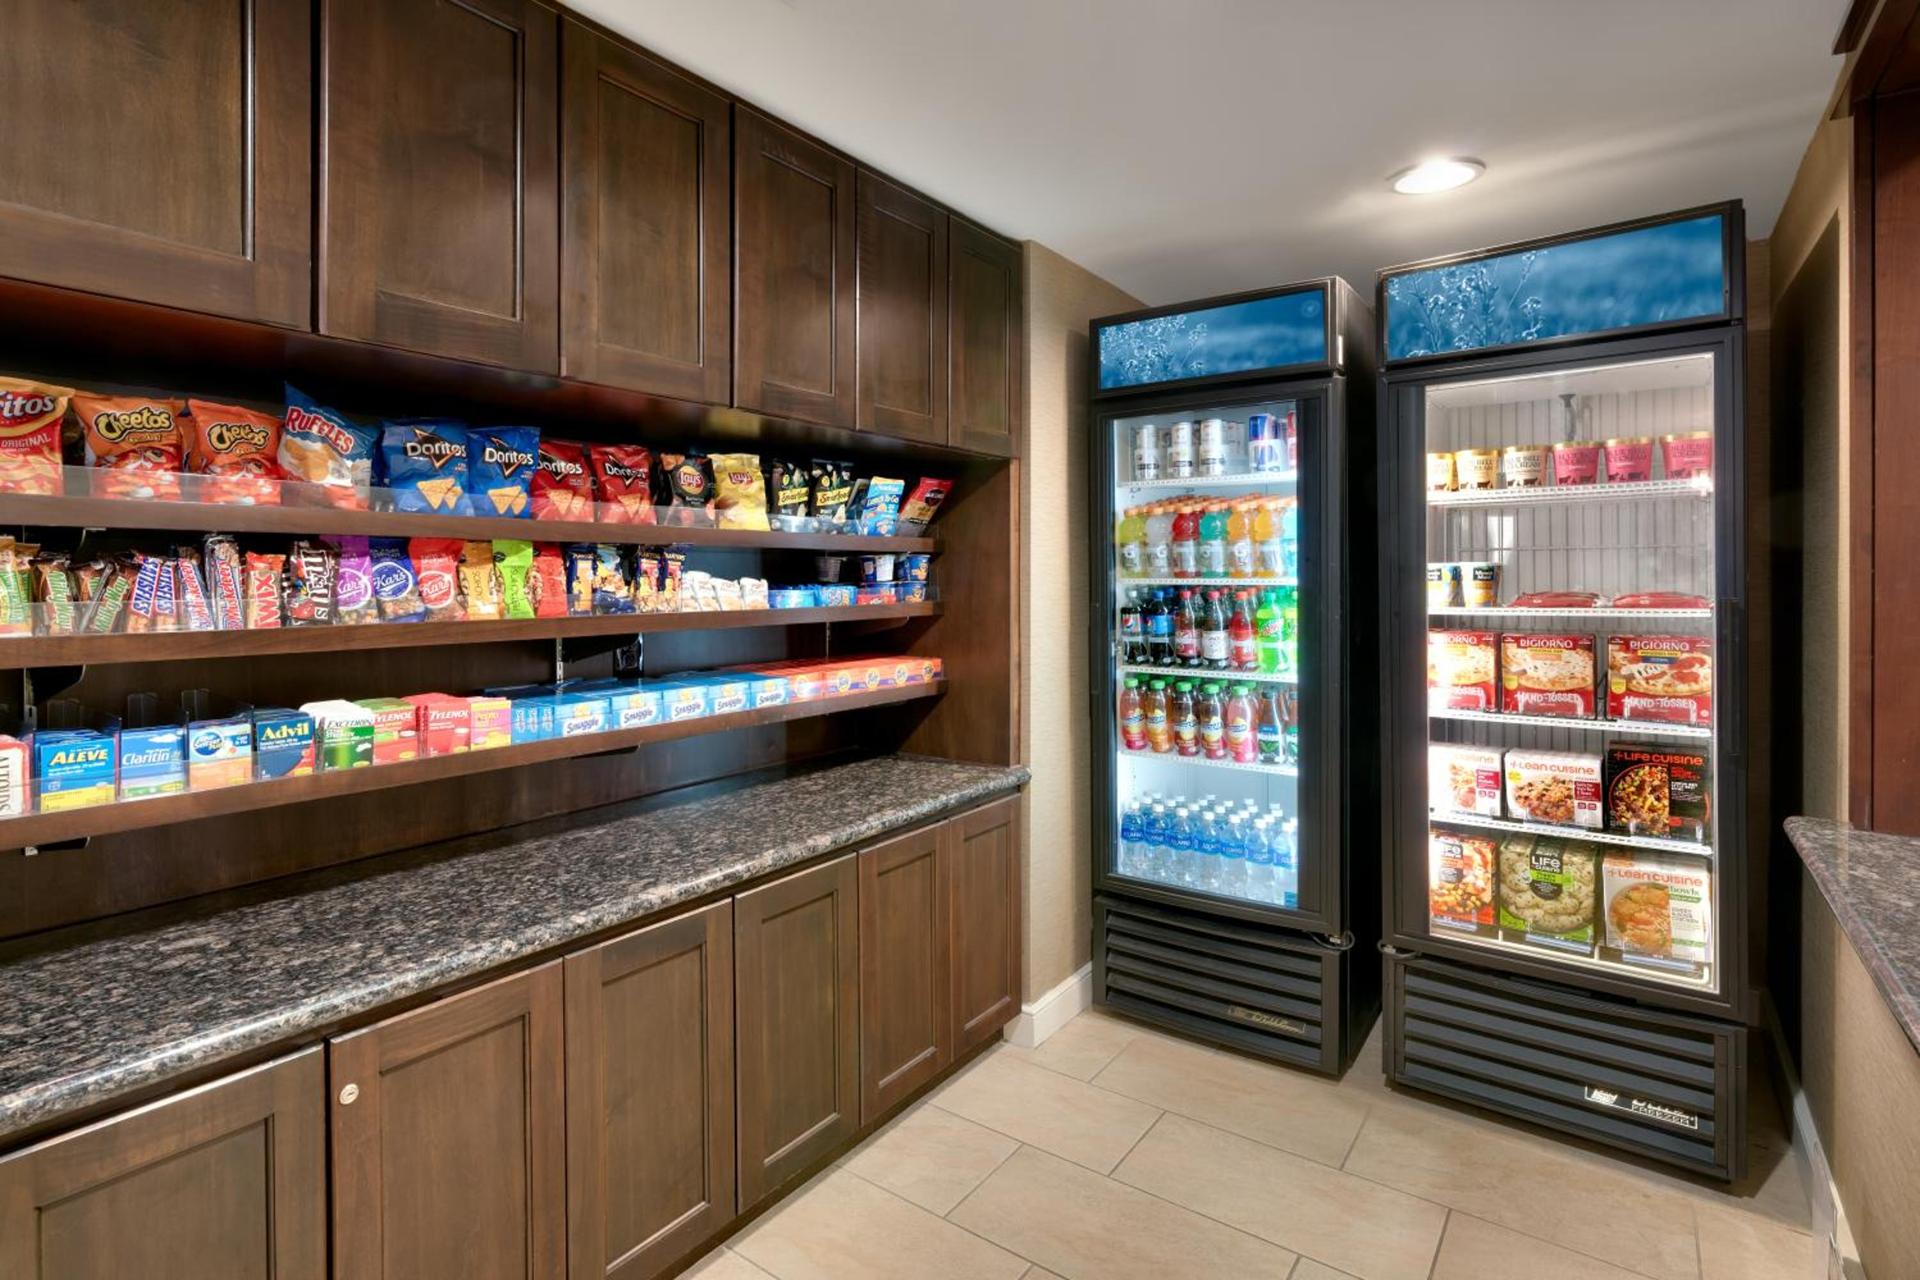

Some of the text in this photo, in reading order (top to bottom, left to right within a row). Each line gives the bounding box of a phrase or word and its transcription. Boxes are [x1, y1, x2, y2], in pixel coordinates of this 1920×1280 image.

[0, 391, 54, 417] itos
[96, 408, 172, 441] Cheetos
[286, 406, 353, 454] RUFFLES
[1, 433, 51, 448] ORIGINAL
[208, 424, 268, 450] Cheetos
[406, 441, 466, 458] Doritos
[484, 447, 533, 466] Doritos
[605, 463, 648, 478] Doritos
[133, 557, 158, 615] SATISFIES
[156, 562, 174, 614] ATISFIES
[375, 572, 406, 592] Kar's
[1520, 639, 1573, 649] DIGIORNO
[1630, 640, 1690, 652] DIGIORNO
[717, 697, 743, 711] Snuggle
[759, 691, 782, 705] Snuggle
[1622, 695, 1697, 709] HAND-TOSSED
[372, 711, 414, 723] TYLENOL
[430, 710, 470, 720] TYLENOL
[623, 708, 653, 723] Snuggle
[674, 702, 701, 717] Snuggle
[263, 722, 309, 741] Advil
[566, 719, 599, 734] Snuggle
[50, 749, 108, 766] ALEVE
[122, 750, 170, 766] Claritin
